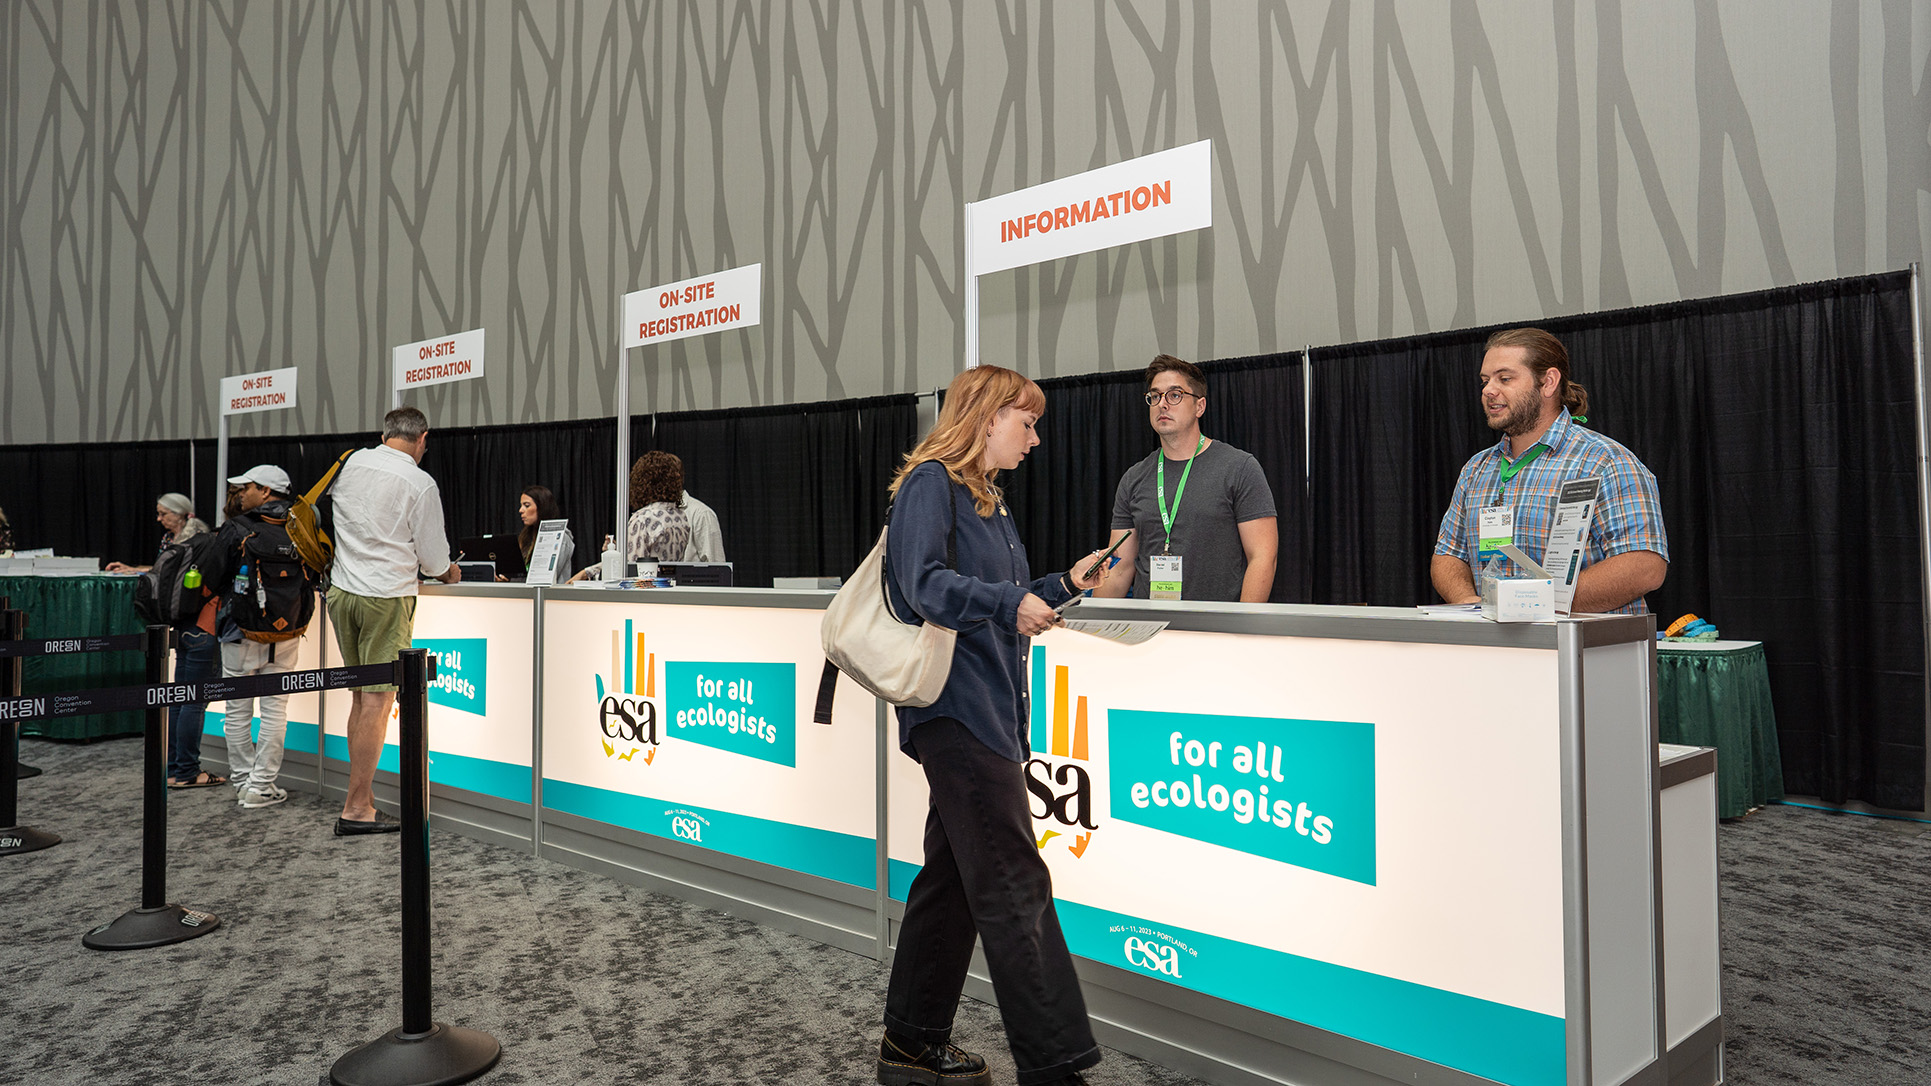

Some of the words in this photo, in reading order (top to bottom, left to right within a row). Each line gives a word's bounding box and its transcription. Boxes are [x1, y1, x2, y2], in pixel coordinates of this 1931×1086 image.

[1001, 180, 1171, 243] INFORMATION
[660, 281, 715, 309] ON-SITE
[640, 304, 740, 339] REGISTRATION
[419, 341, 455, 360] ON-SITE
[242, 376, 272, 391] ON-SITE
[405, 359, 471, 383] REGISTRATION
[231, 392, 286, 410] REGISTRATION
[45, 640, 81, 653] OREGON
[445, 650, 461, 671] all
[147, 684, 196, 705] OREGON
[282, 672, 324, 691] OREGON
[696, 674, 724, 698] for
[728, 678, 753, 705] all
[0, 698, 45, 720] REGON
[54, 699, 92, 708] Convention
[54, 706, 78, 714] Center
[600, 696, 660, 746] esa
[676, 702, 777, 744] ecologists
[1170, 731, 1222, 768] for
[1232, 741, 1285, 783] all
[1023, 758, 1099, 830] sa
[1130, 773, 1334, 845] ecologists
[672, 816, 702, 842] esa
[1109, 925, 1120, 933] AUG
[1138, 926, 1152, 936] 2023
[1157, 931, 1188, 952] PORTLAND,
[1188, 947, 1198, 957] OR
[1124, 936, 1182, 979] esa
